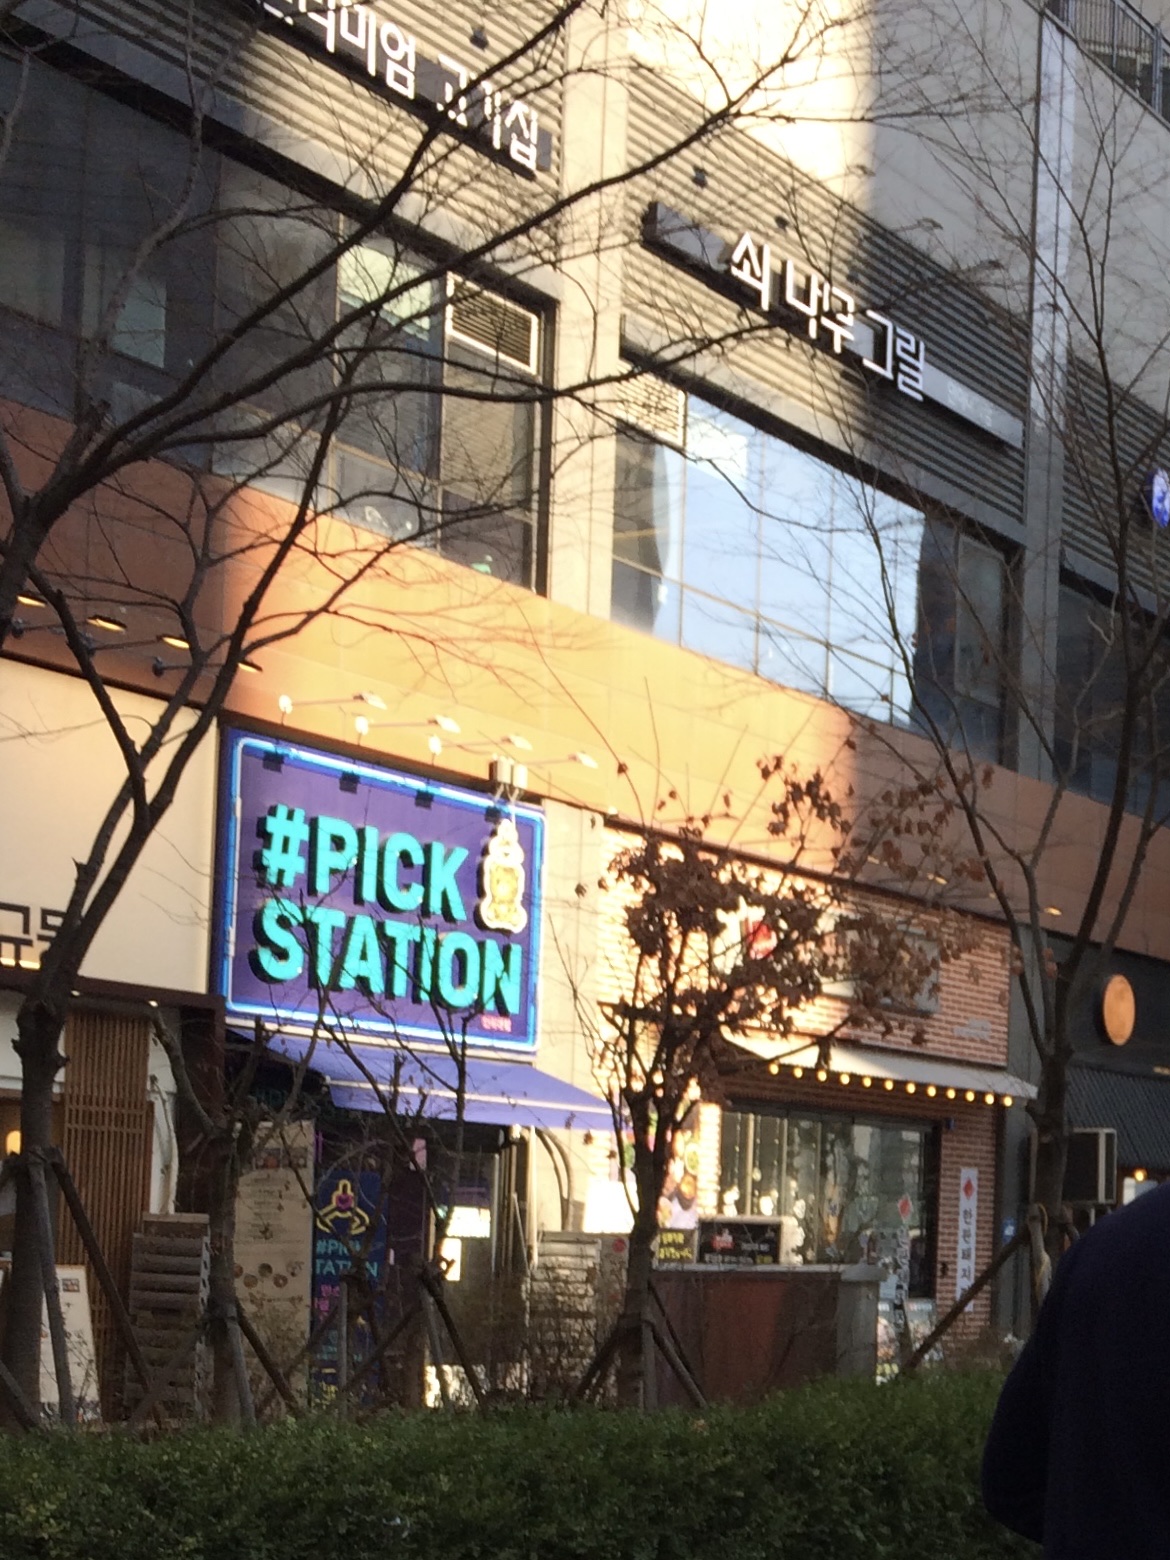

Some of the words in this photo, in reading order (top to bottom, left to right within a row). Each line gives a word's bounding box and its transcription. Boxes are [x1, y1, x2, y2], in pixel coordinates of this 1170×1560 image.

[256, 0, 416, 100] 리미엄
[260, 803, 470, 923] #PICK
[254, 897, 523, 1015] STATION
